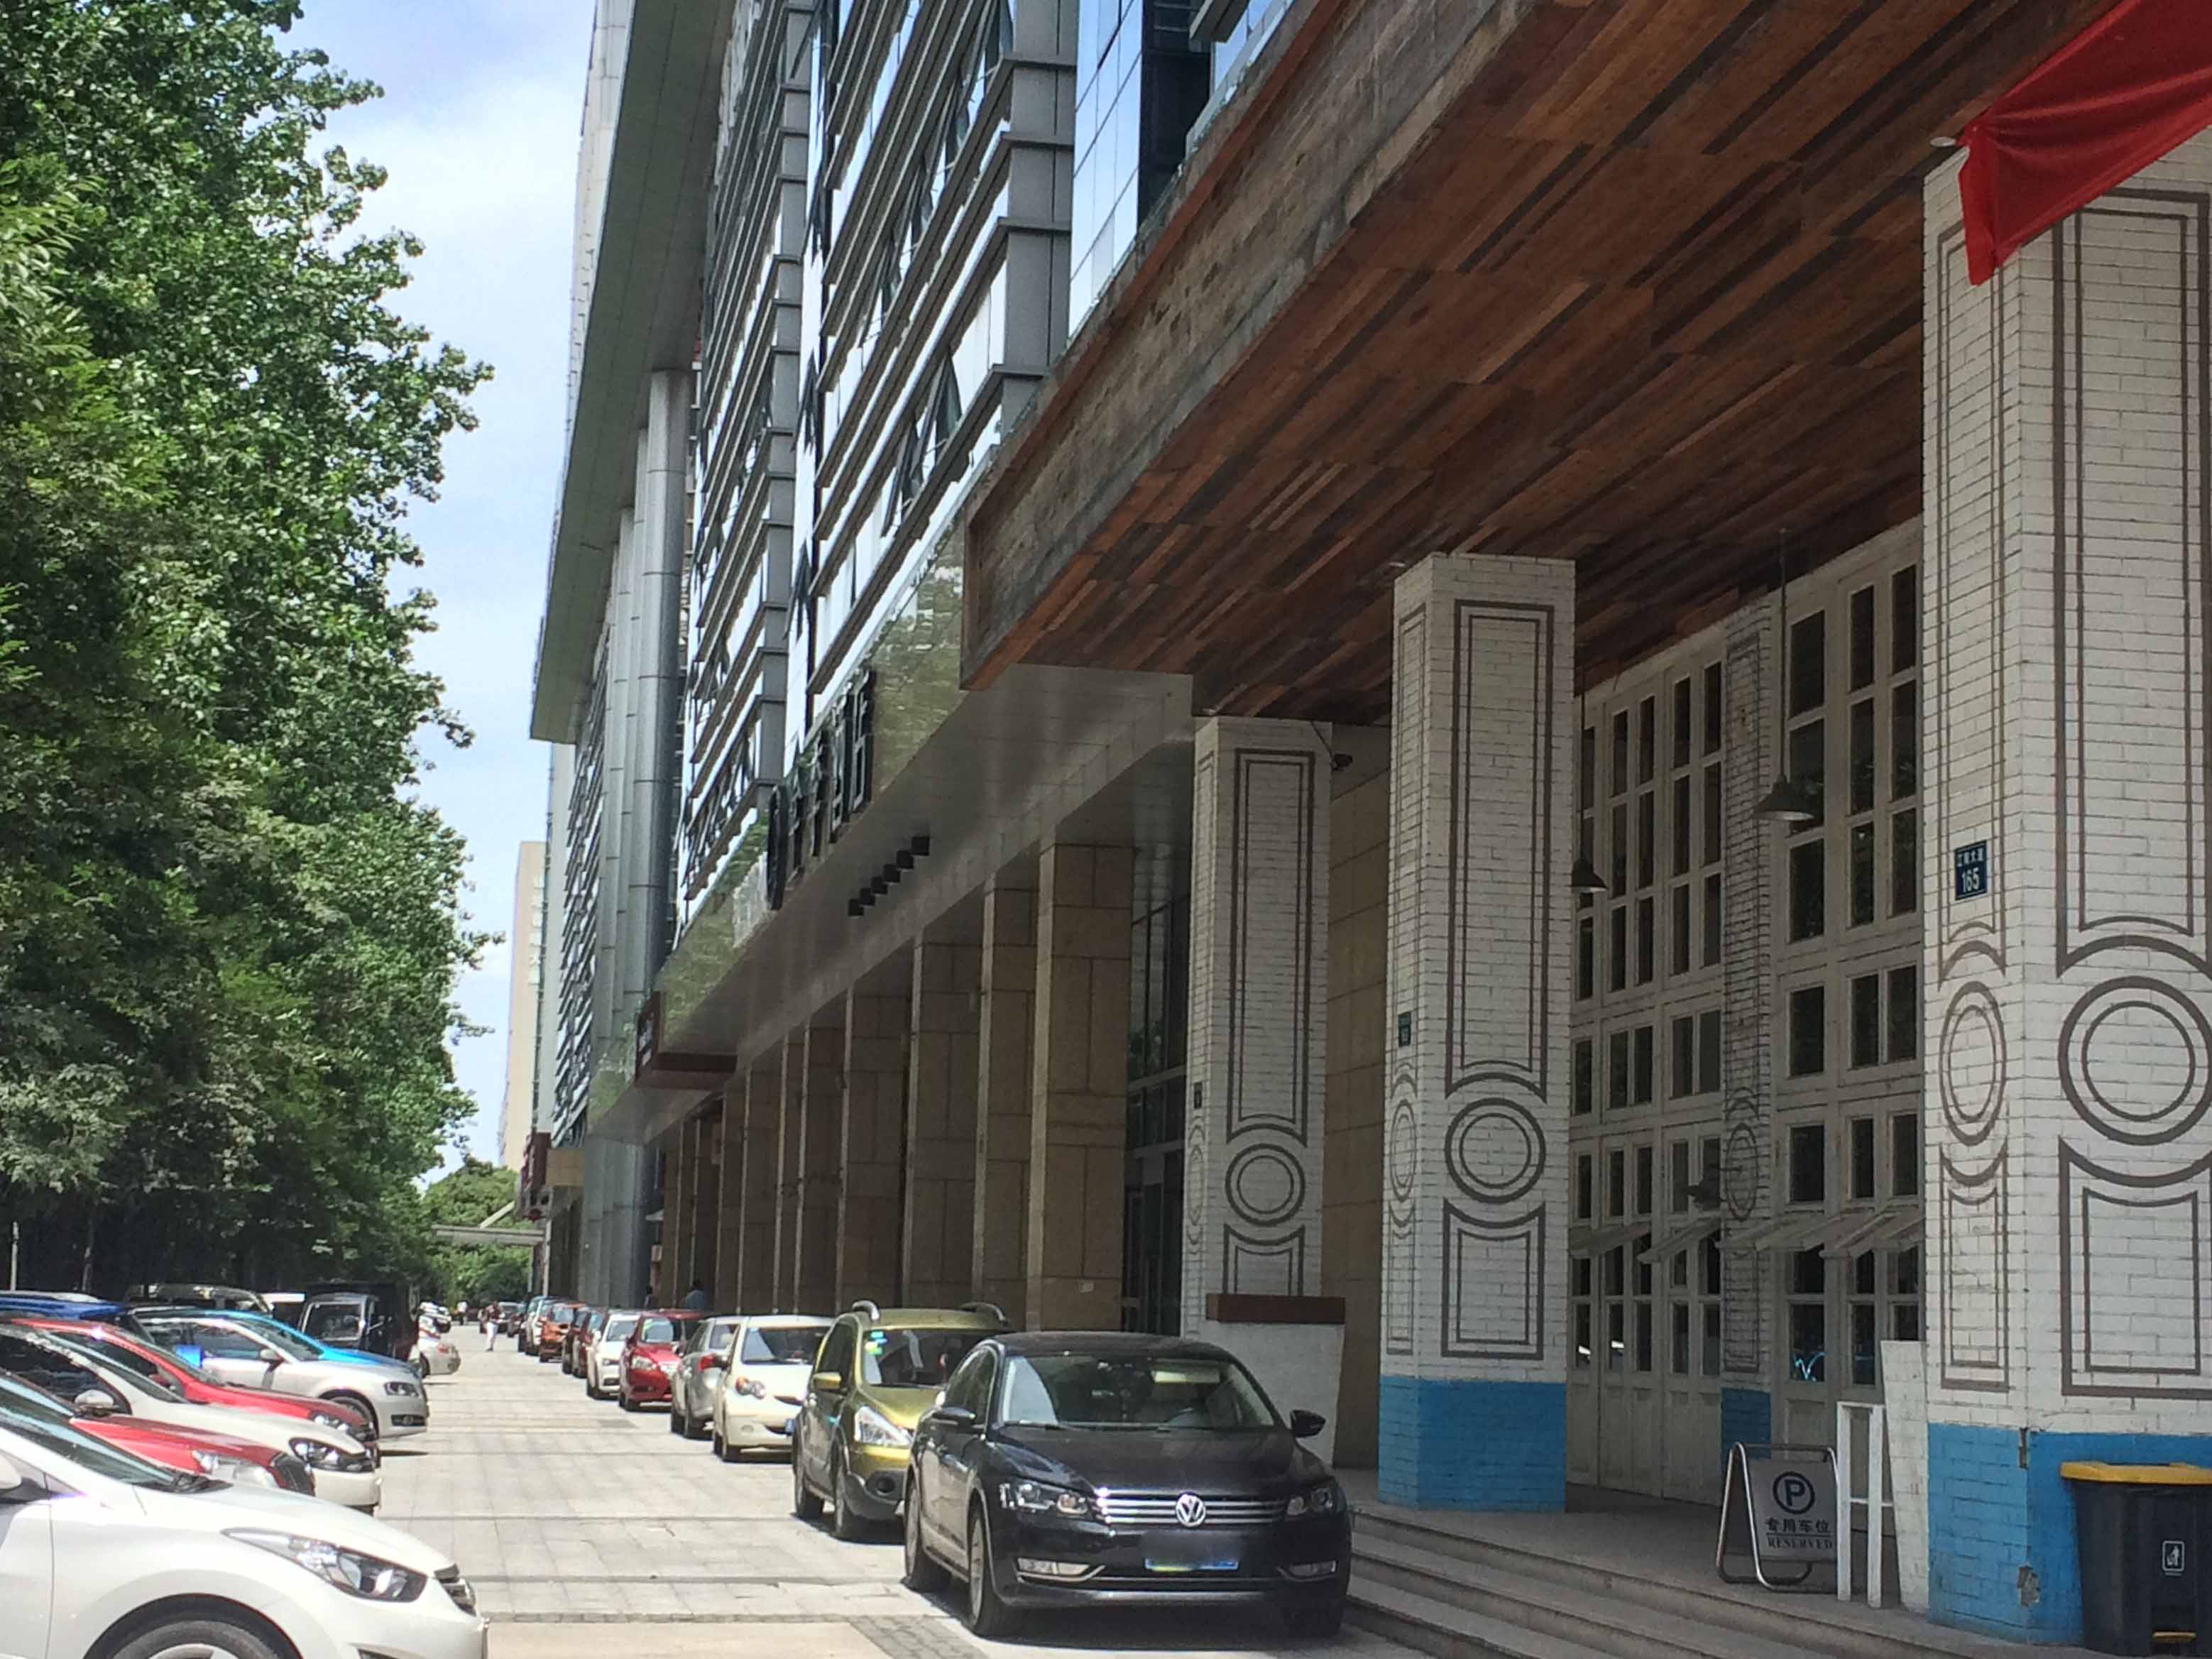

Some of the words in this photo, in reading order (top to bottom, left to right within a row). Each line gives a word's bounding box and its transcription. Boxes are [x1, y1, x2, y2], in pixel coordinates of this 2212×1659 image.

[1961, 867, 1980, 893] 165
[1783, 1479, 1806, 1506] P
[1765, 1517, 1830, 1533] 专用车位
[1767, 1537, 1832, 1548] RESERVED
